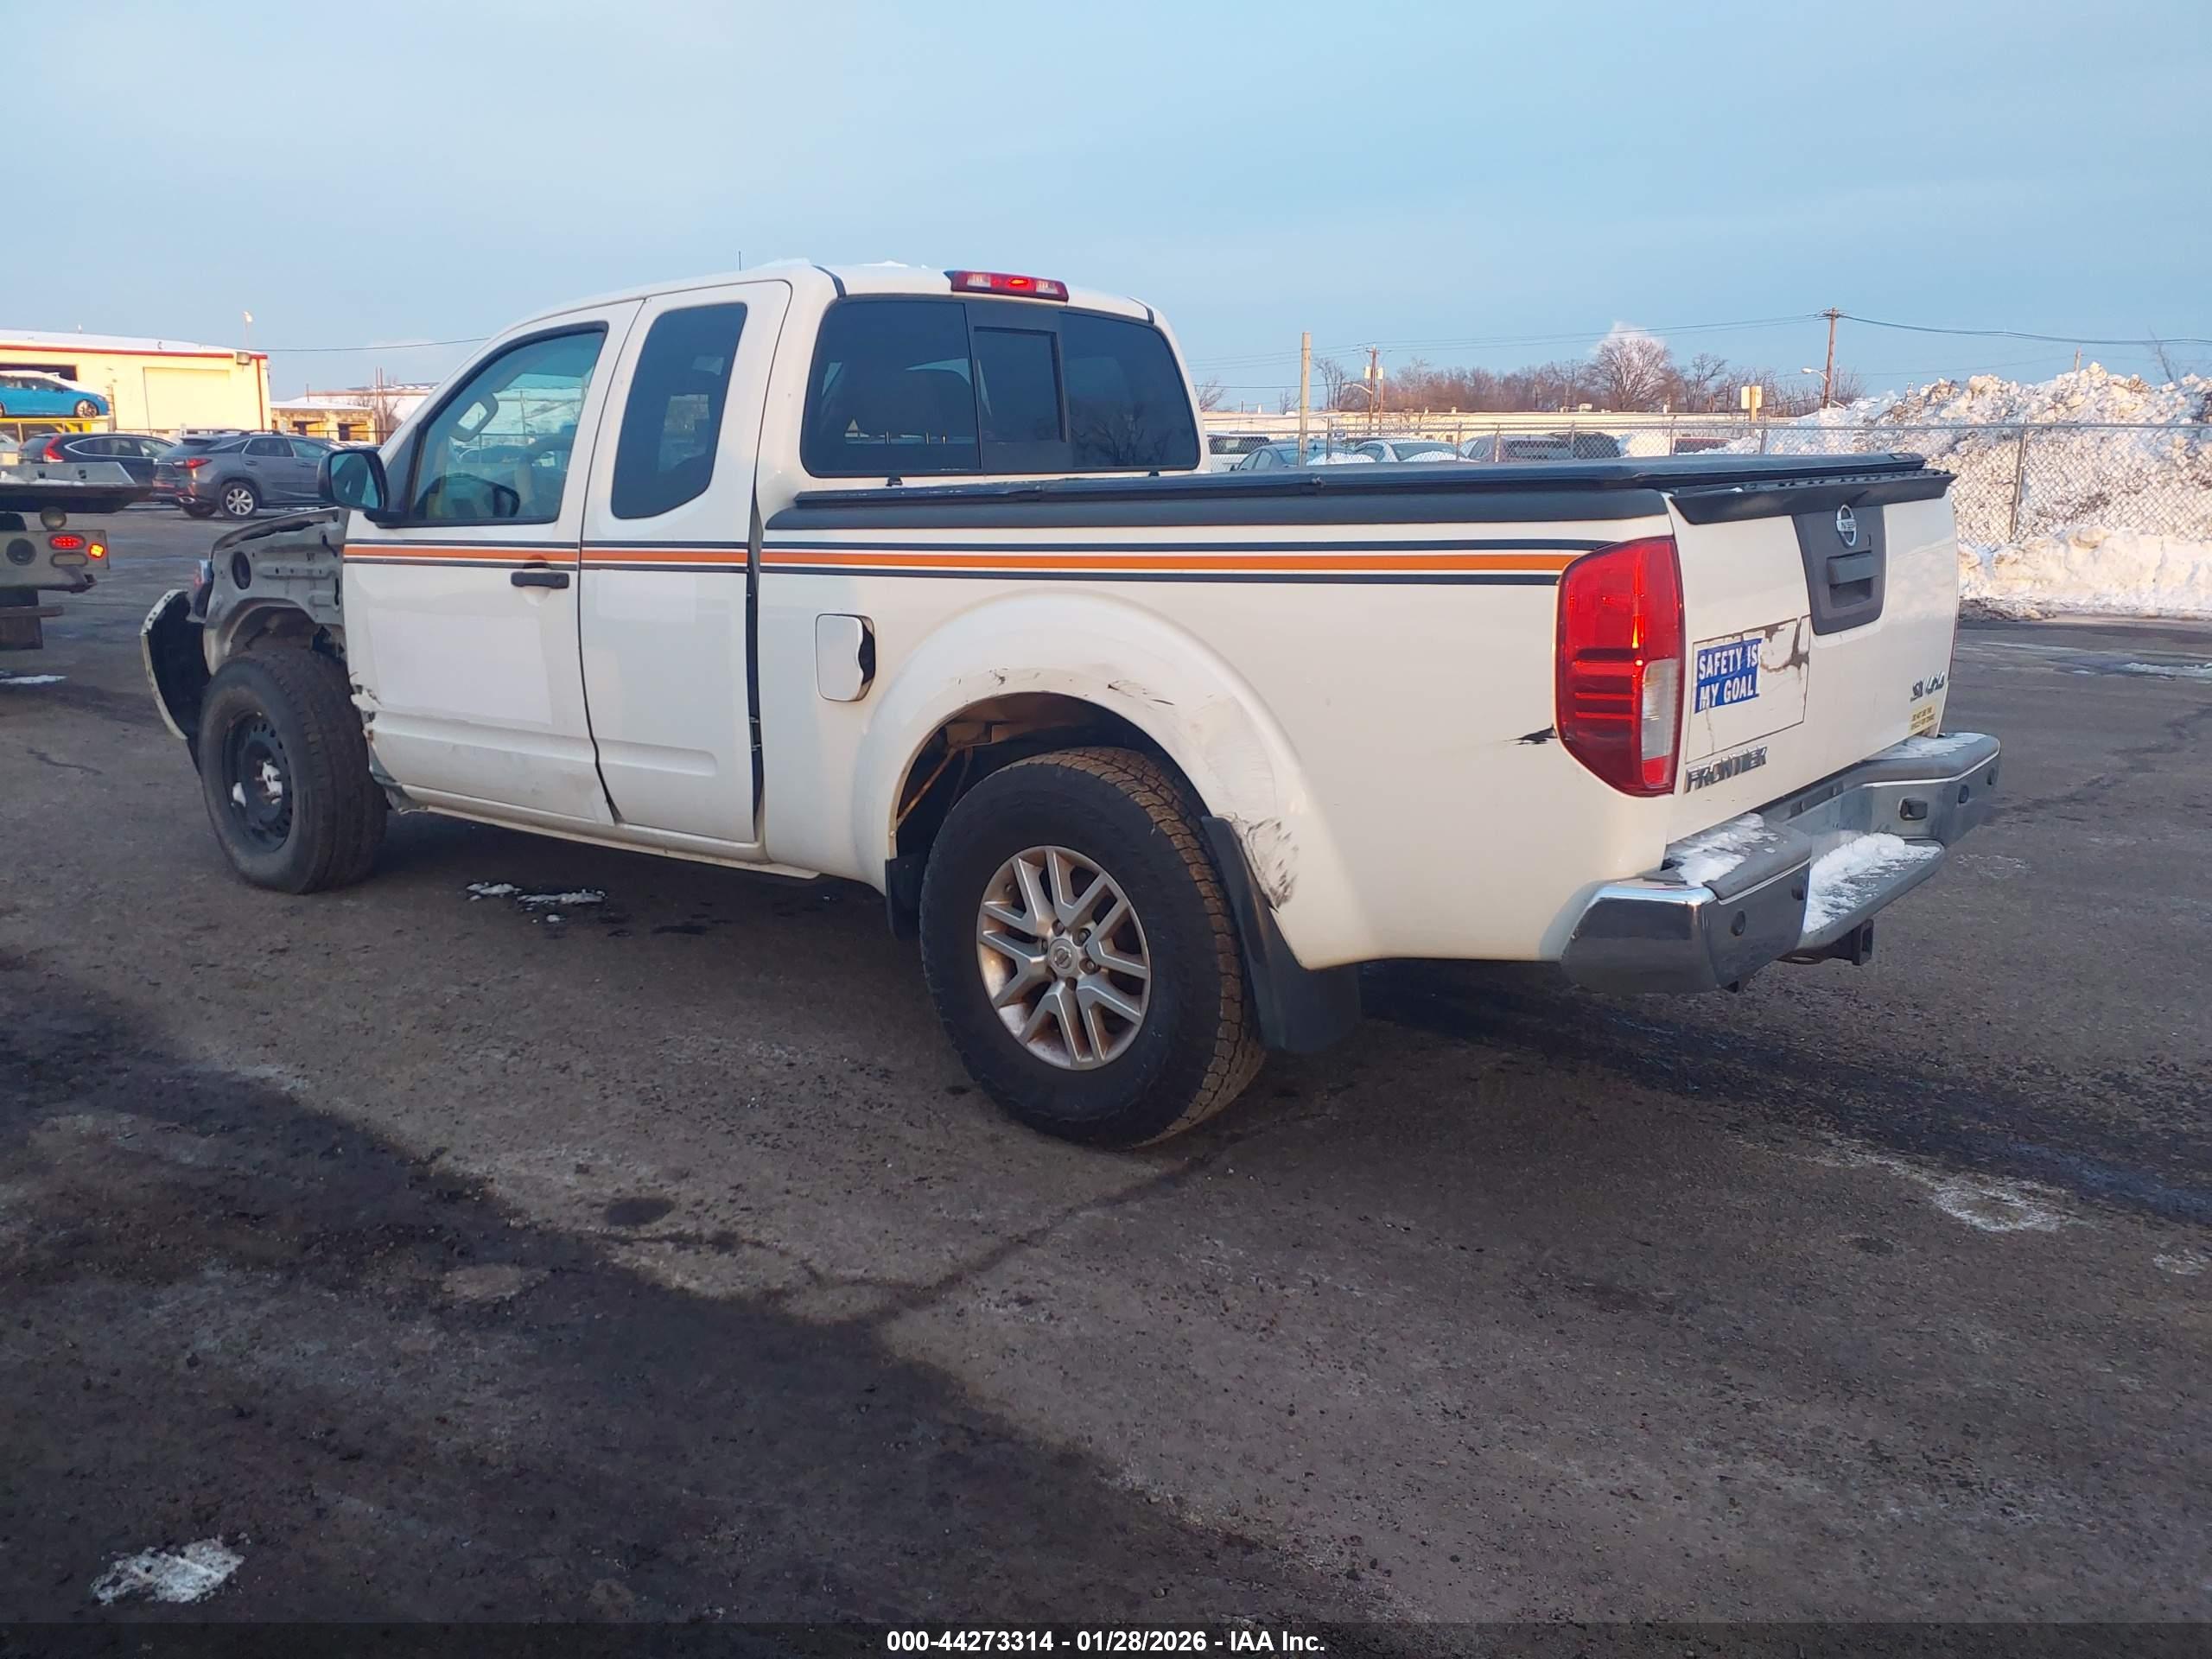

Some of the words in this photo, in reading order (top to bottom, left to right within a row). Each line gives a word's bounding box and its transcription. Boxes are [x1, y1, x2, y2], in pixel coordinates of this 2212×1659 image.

[1699, 647, 1743, 680] SAFETY
[1747, 644, 1759, 669] IS
[1699, 683, 1720, 711] MY
[1724, 675, 1754, 703] GOAL
[1684, 746, 1768, 794] FRONTIER
